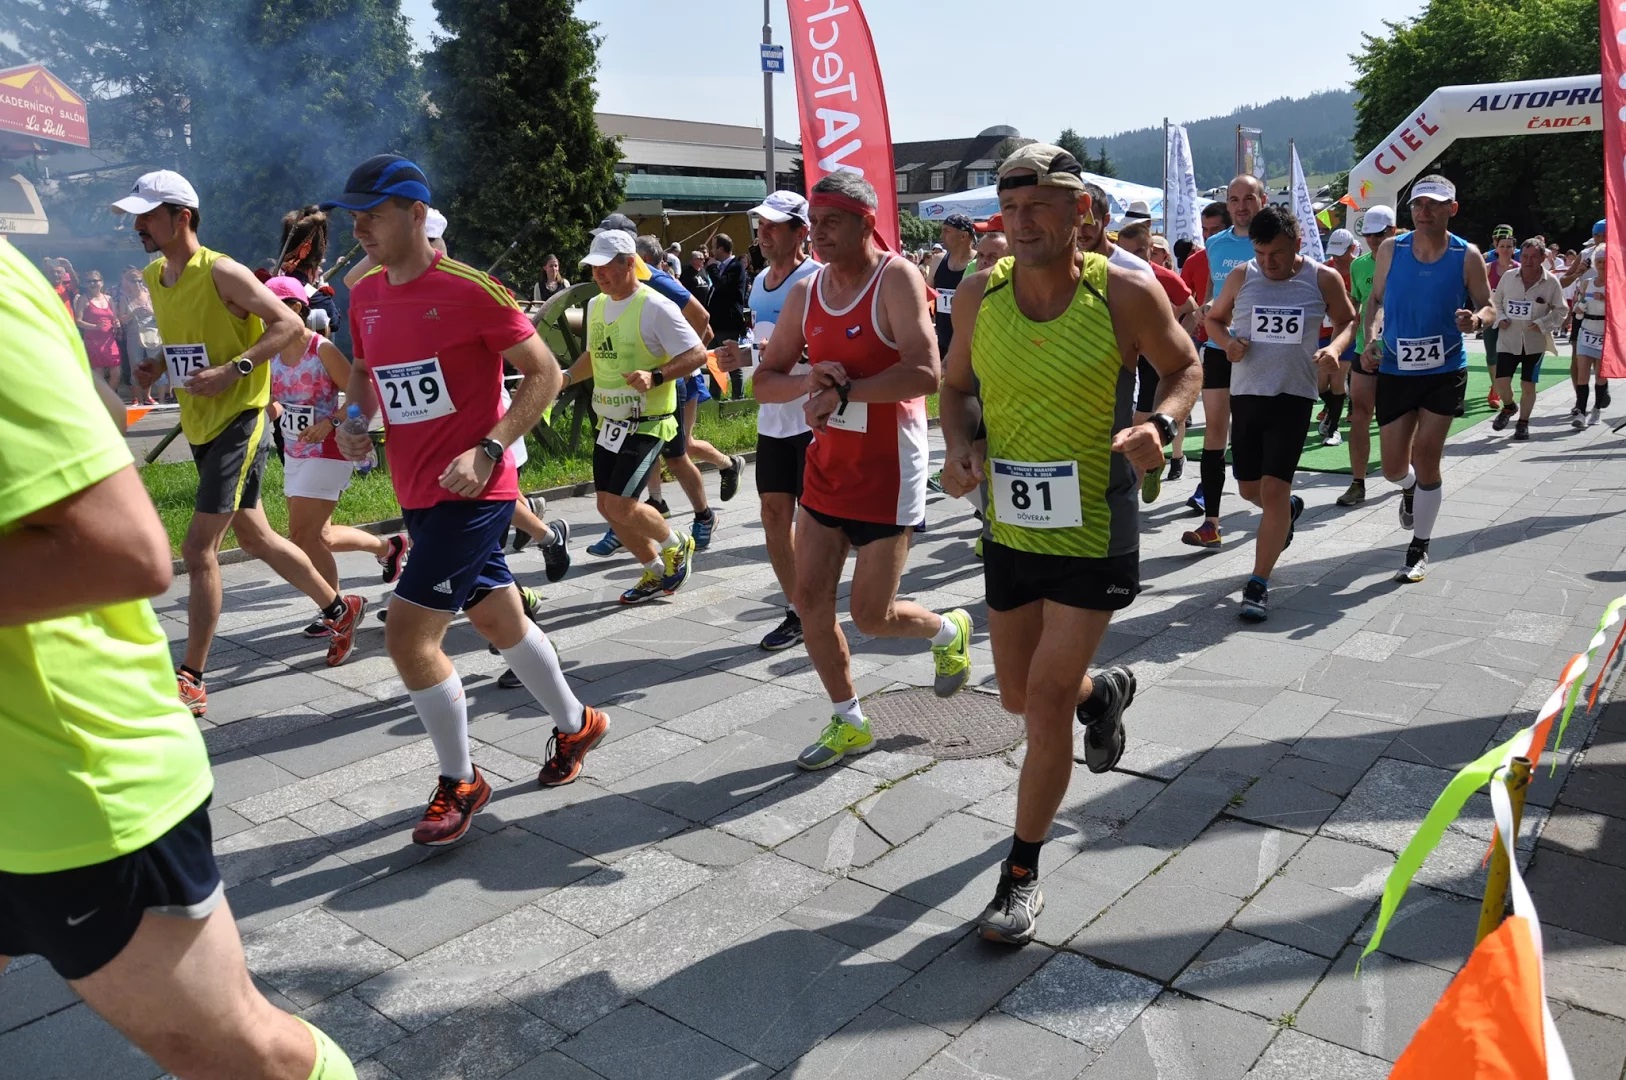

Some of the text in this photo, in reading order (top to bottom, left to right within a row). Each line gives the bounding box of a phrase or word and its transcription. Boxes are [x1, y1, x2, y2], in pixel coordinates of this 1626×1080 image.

[60, 110, 85, 123] SALÓN
[1527, 116, 1592, 129] ČADCA
[25, 115, 66, 137] La Belle
[1508, 305, 1529, 315] 233
[1256, 315, 1299, 334] 236
[594, 350, 618, 360] adidas
[1402, 345, 1440, 362] 224
[171, 355, 204, 376] 175
[385, 377, 439, 408] 219
[593, 393, 641, 407] ackaging
[282, 411, 309, 431] 218
[1011, 480, 1052, 511] 81
[1017, 512, 1045, 522] DÔVERA
